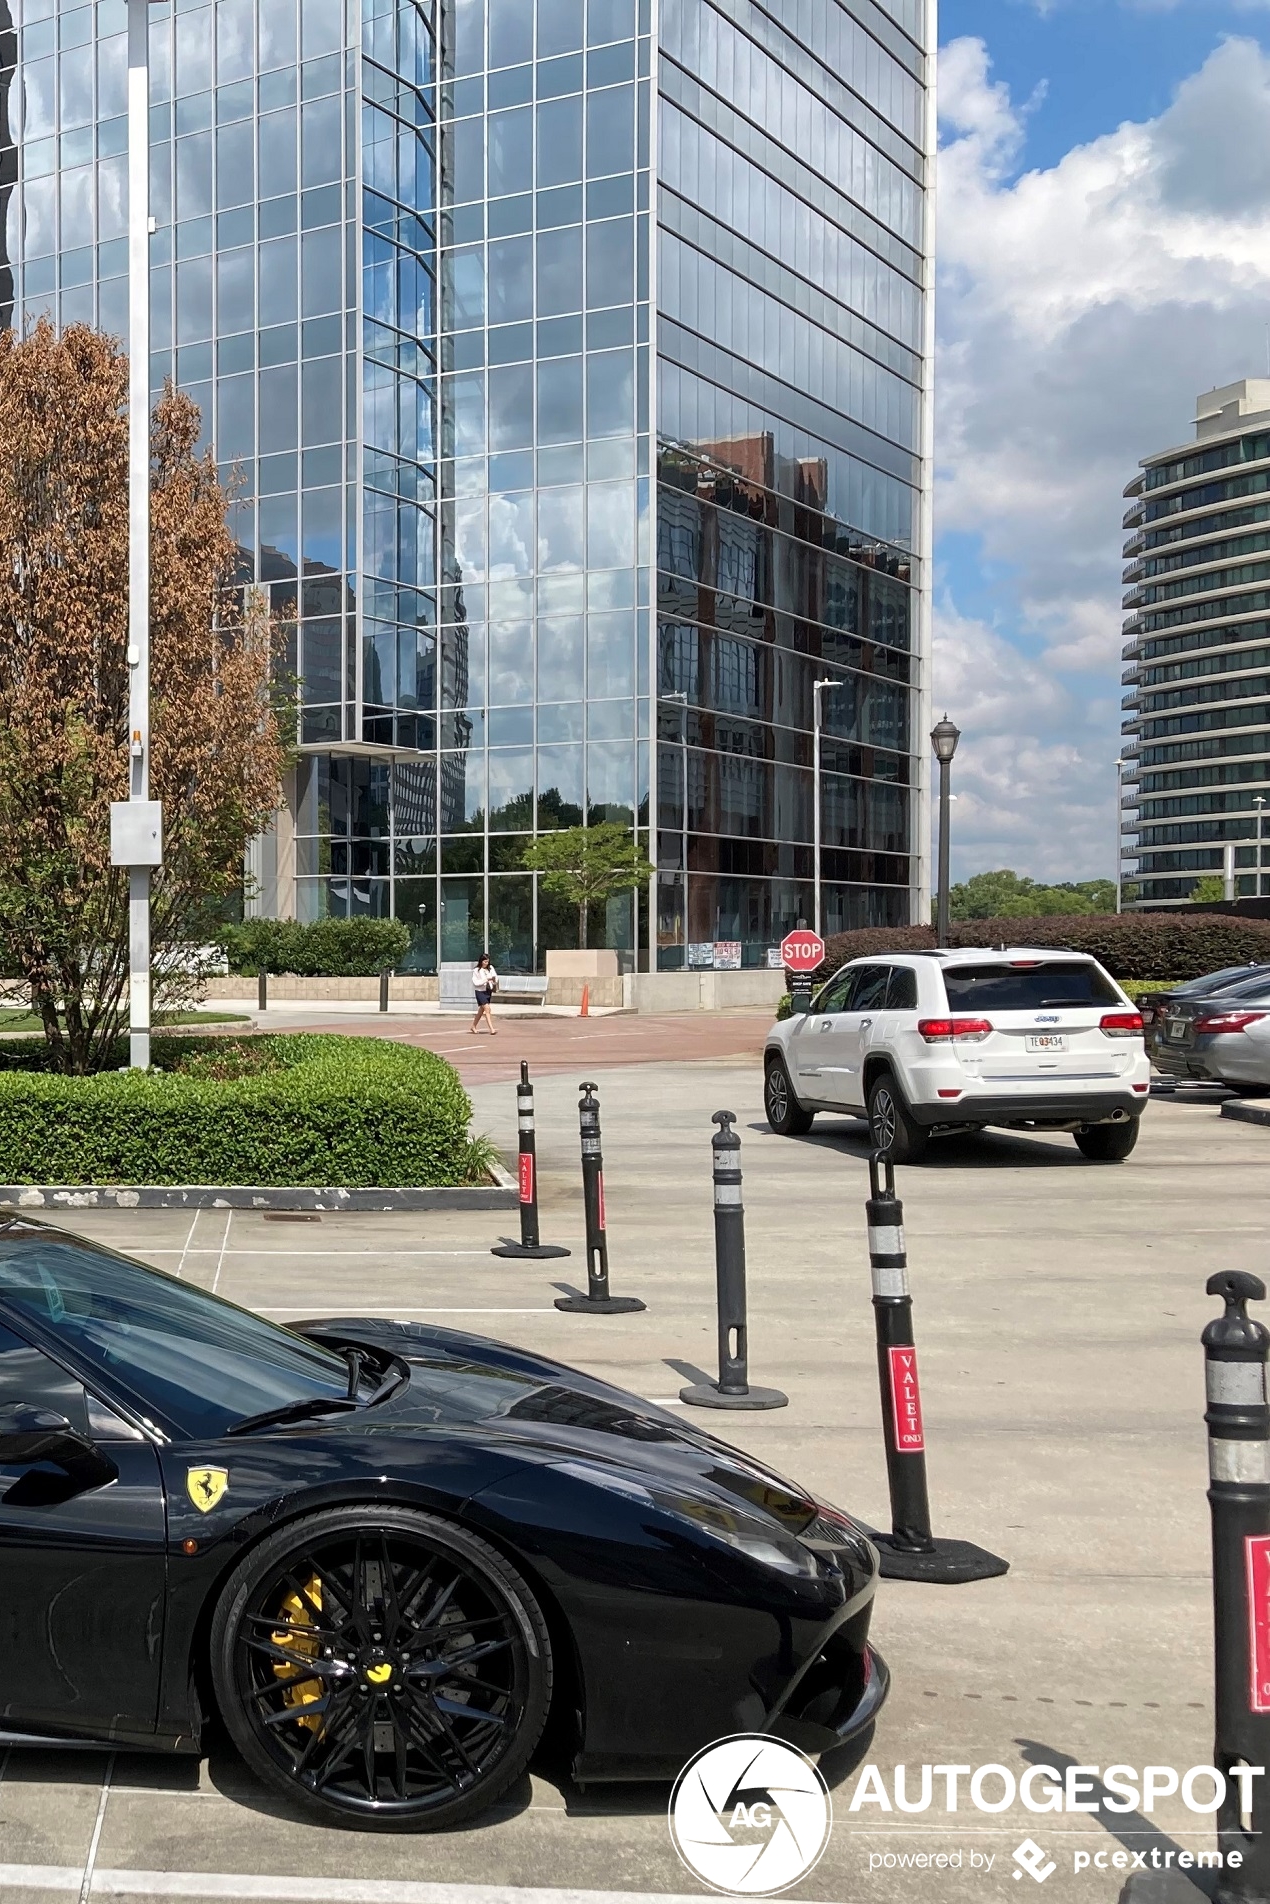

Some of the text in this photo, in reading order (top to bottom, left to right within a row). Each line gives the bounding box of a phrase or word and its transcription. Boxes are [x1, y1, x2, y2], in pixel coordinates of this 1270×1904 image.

[784, 943, 821, 958] STOP
[1034, 1014, 1060, 1023] Jeep
[900, 1355, 918, 1431] VALET
[902, 1434, 922, 1443] ONLY
